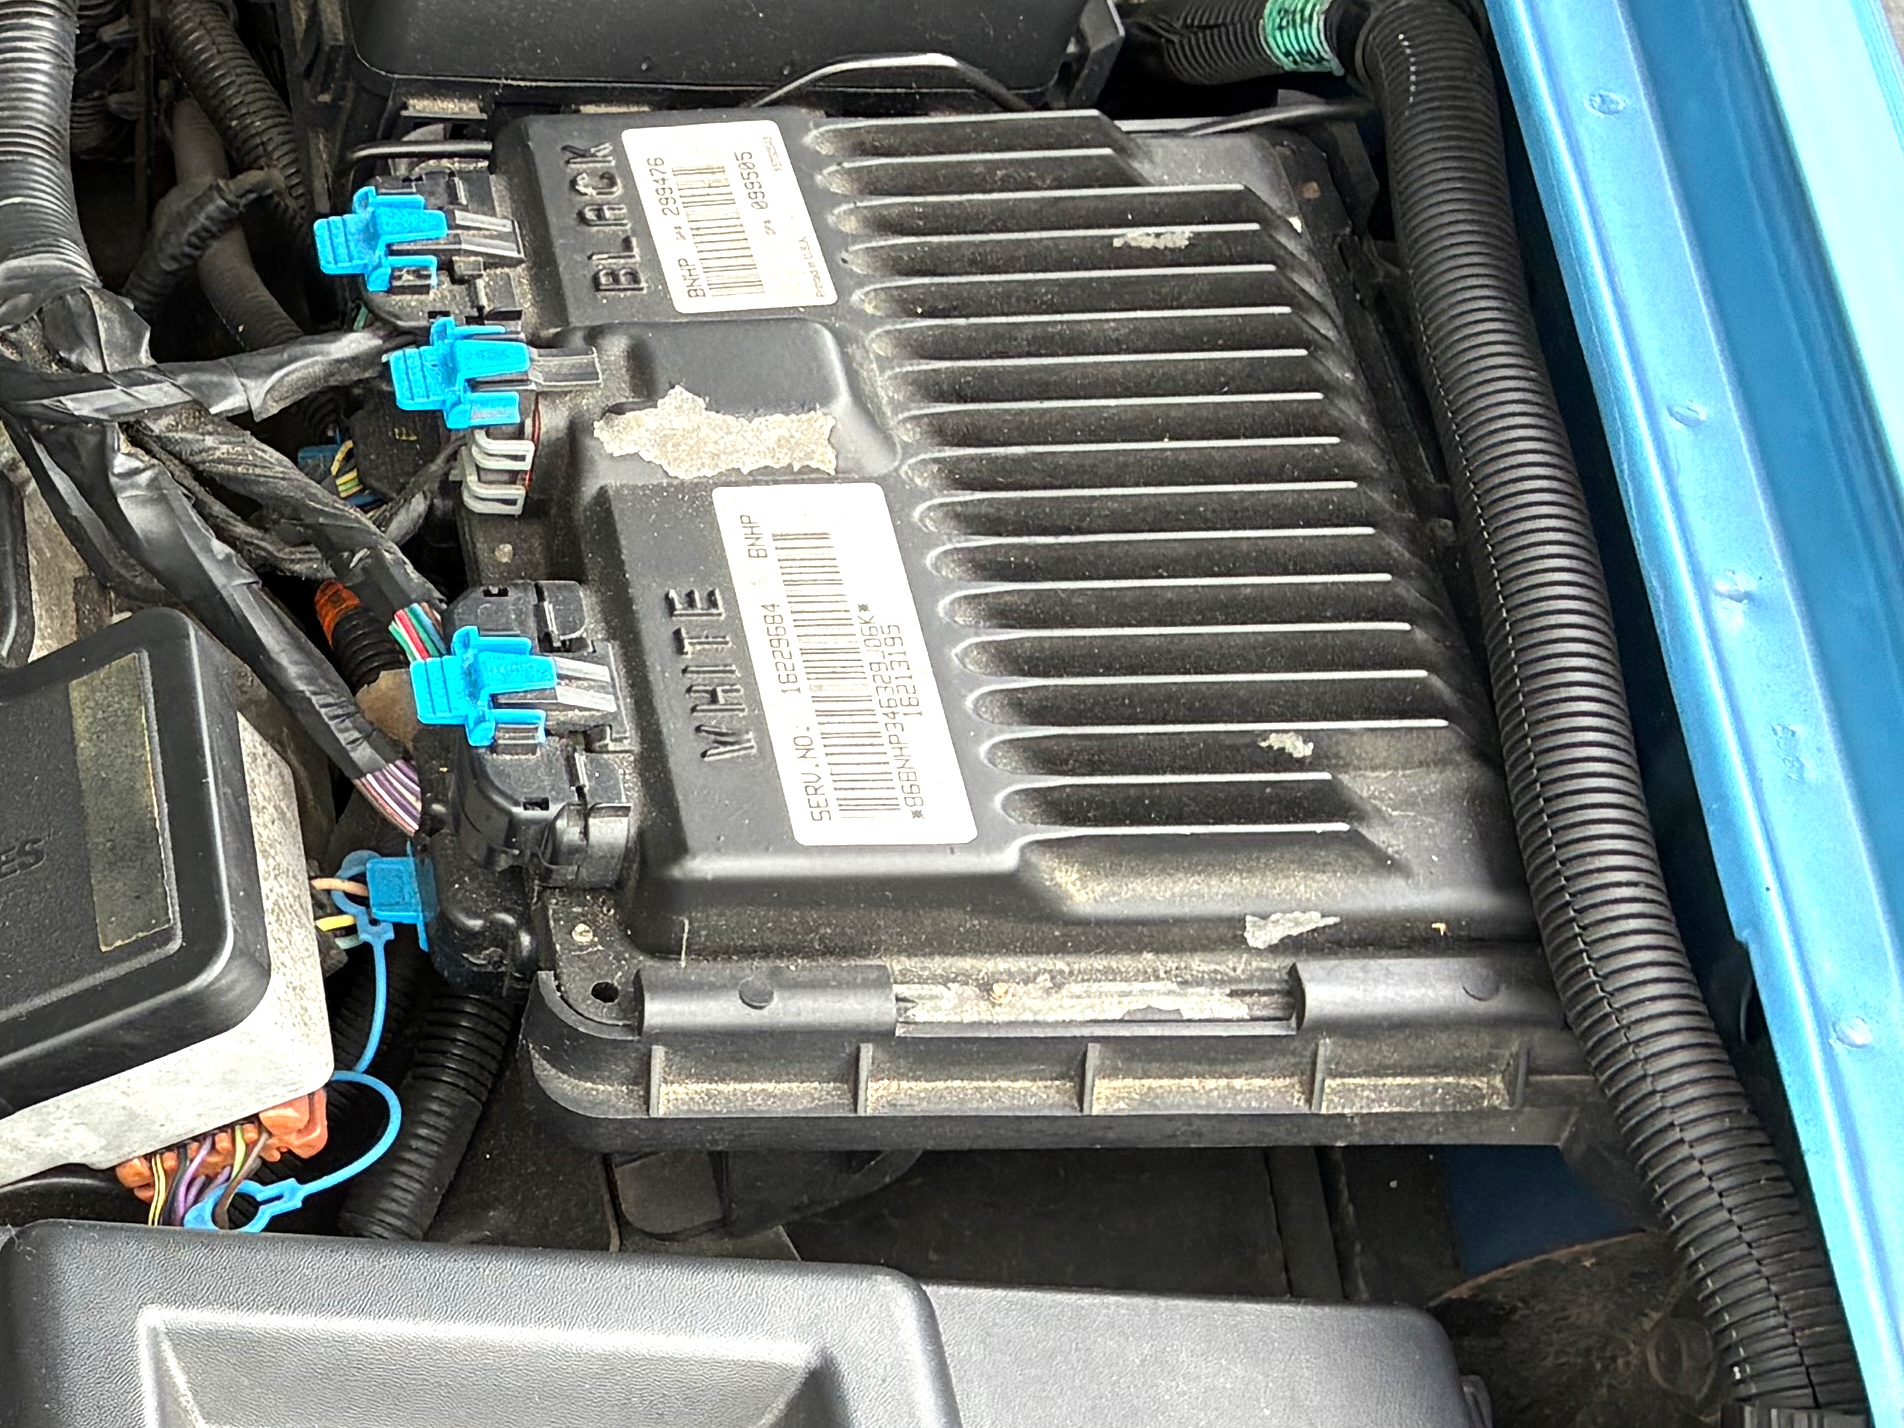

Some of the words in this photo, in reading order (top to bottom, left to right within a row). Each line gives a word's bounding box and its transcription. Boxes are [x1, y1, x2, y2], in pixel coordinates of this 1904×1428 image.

[574, 141, 648, 297] BLACK
[646, 156, 681, 217] 299476
[733, 151, 770, 210] 099505
[664, 587, 757, 762] WHITE
[760, 603, 801, 694] 16229684
[880, 624, 924, 717] 16213195
